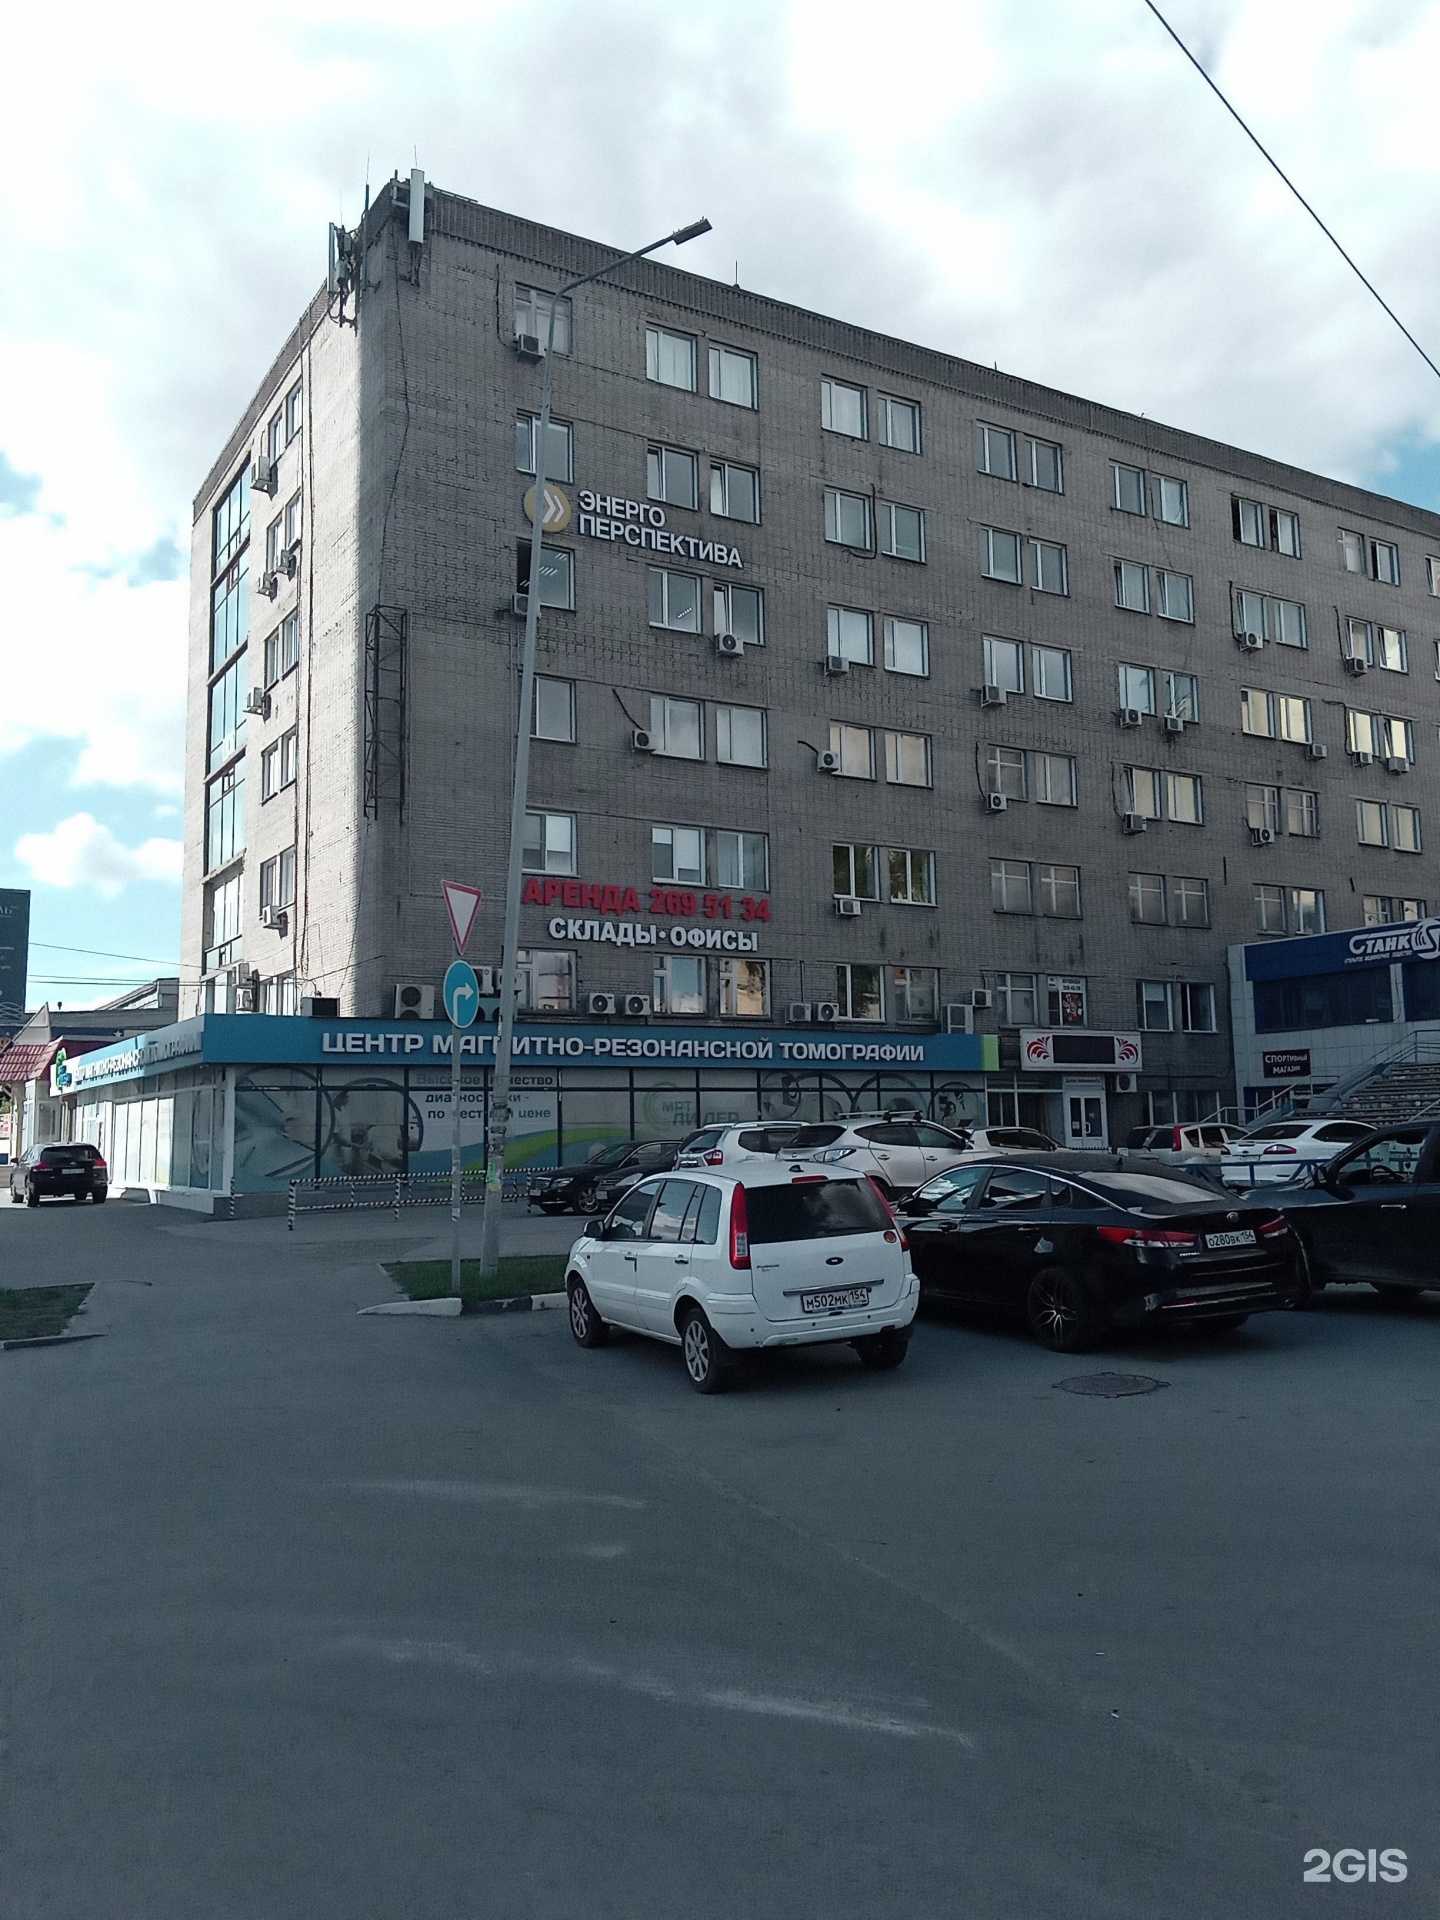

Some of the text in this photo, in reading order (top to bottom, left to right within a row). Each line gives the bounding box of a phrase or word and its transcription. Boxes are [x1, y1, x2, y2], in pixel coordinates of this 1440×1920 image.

[578, 489, 666, 528] ЭНЕРГО
[578, 513, 744, 569] ПЕРСПЕКТИВА
[522, 878, 772, 922] АРЕНДА 269 51 34
[322, 1033, 424, 1054] ЦЕНТР
[779, 1040, 925, 1062] ТОМОГРАФИИ
[428, 1110, 445, 1119] по
[518, 1109, 551, 1118] цене
[662, 1101, 691, 1112] МРТ
